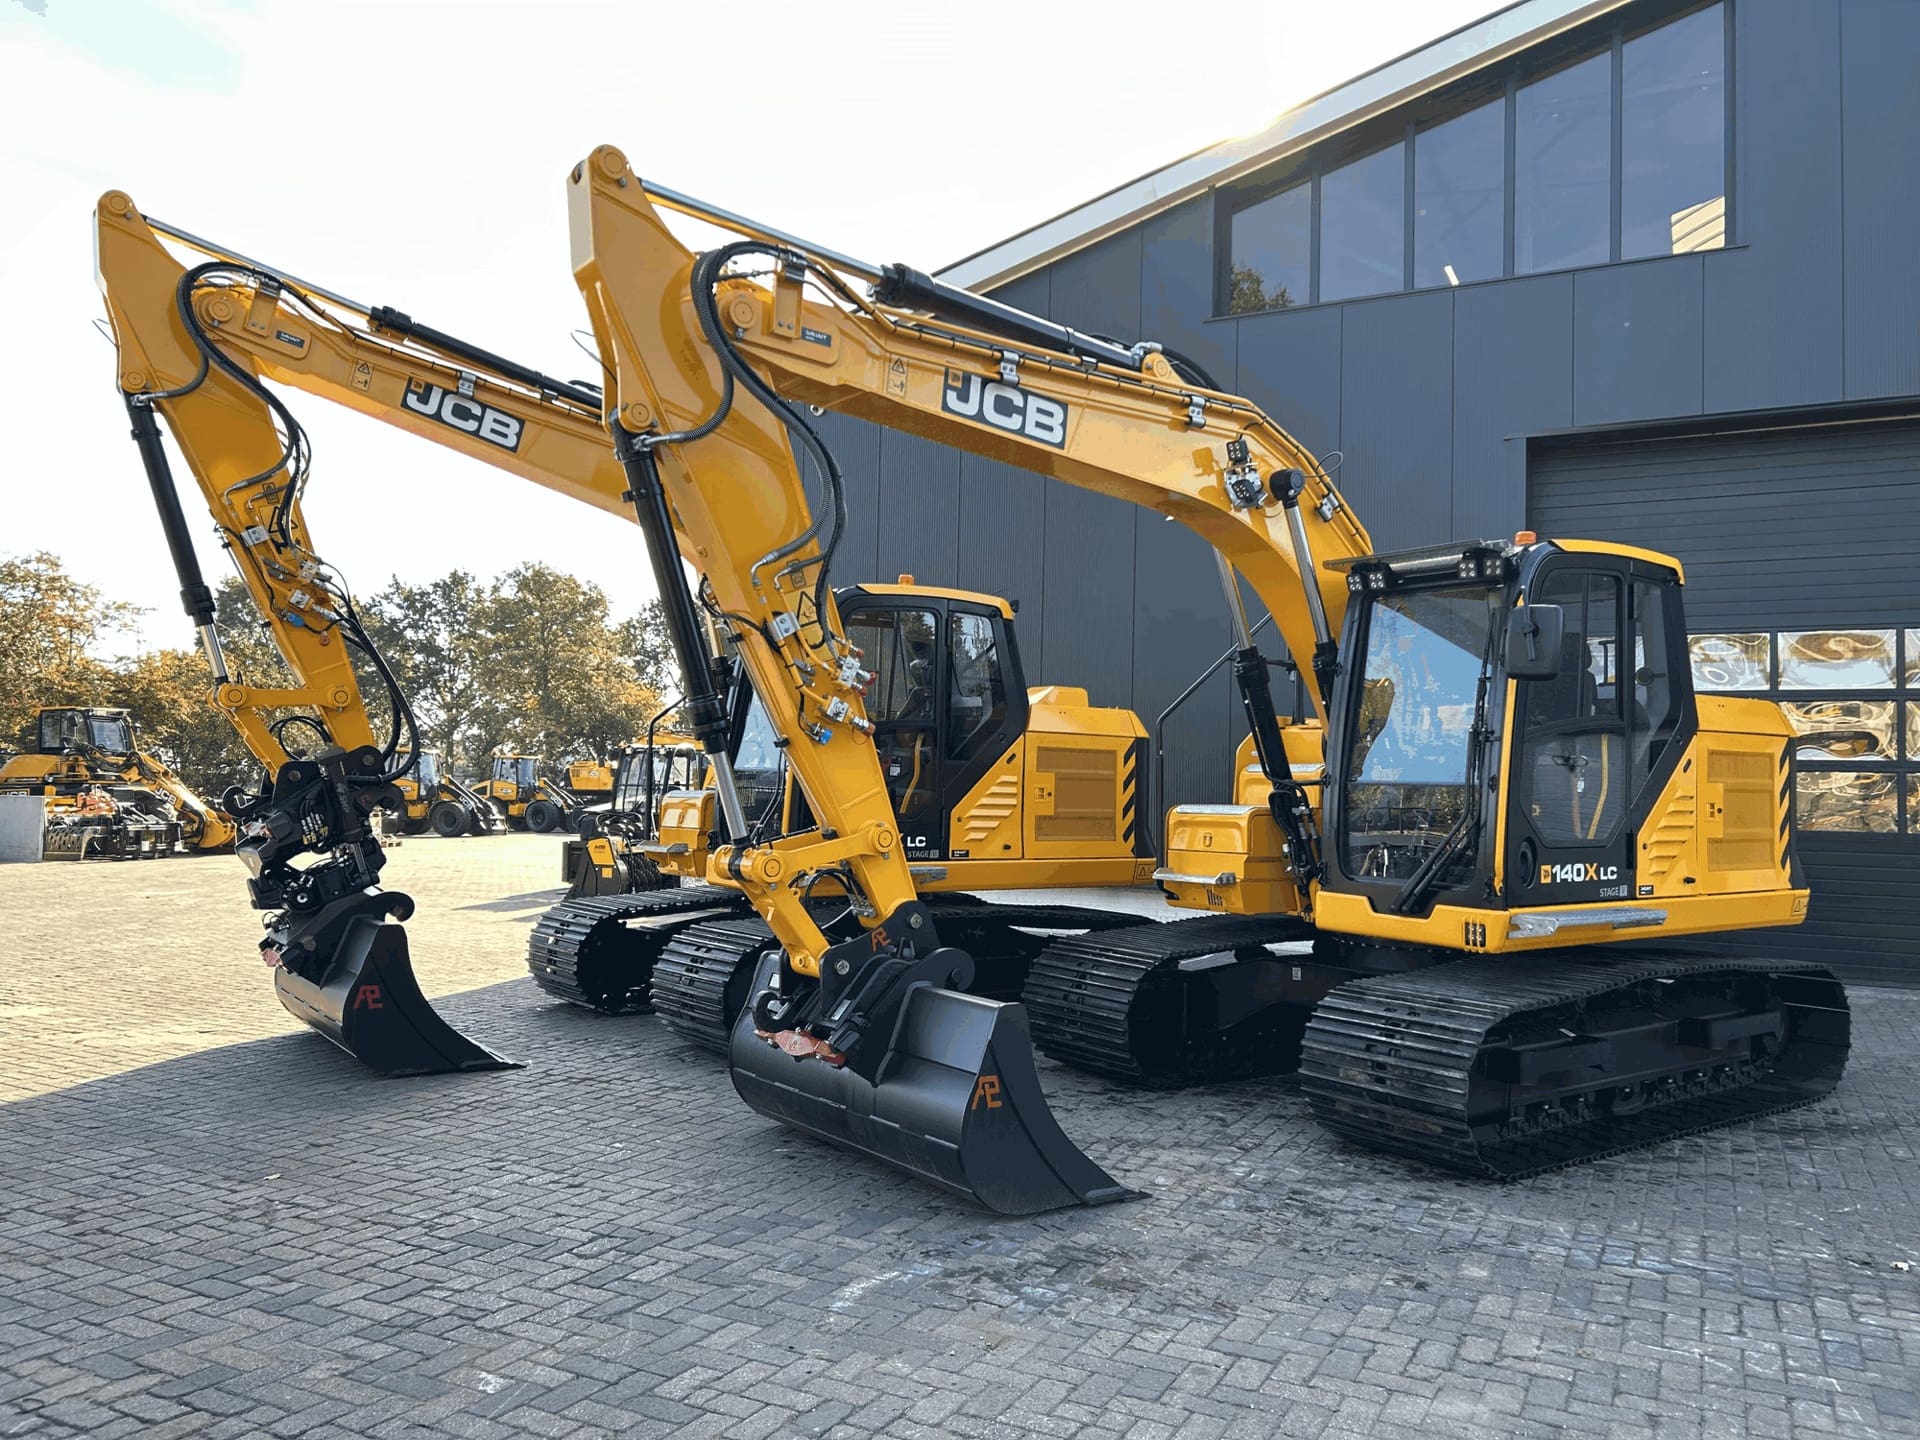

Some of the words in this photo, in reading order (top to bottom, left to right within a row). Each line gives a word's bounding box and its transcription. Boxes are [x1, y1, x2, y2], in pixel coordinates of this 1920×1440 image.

[406, 385, 520, 448] JCB
[946, 374, 1065, 444] JCB
[155, 787, 176, 804] JCB
[907, 836, 926, 847] LC
[907, 850, 929, 858] STAGE
[1552, 863, 1598, 883] 140X
[1600, 866, 1617, 880] LC
[1600, 886, 1619, 897] STAGE
